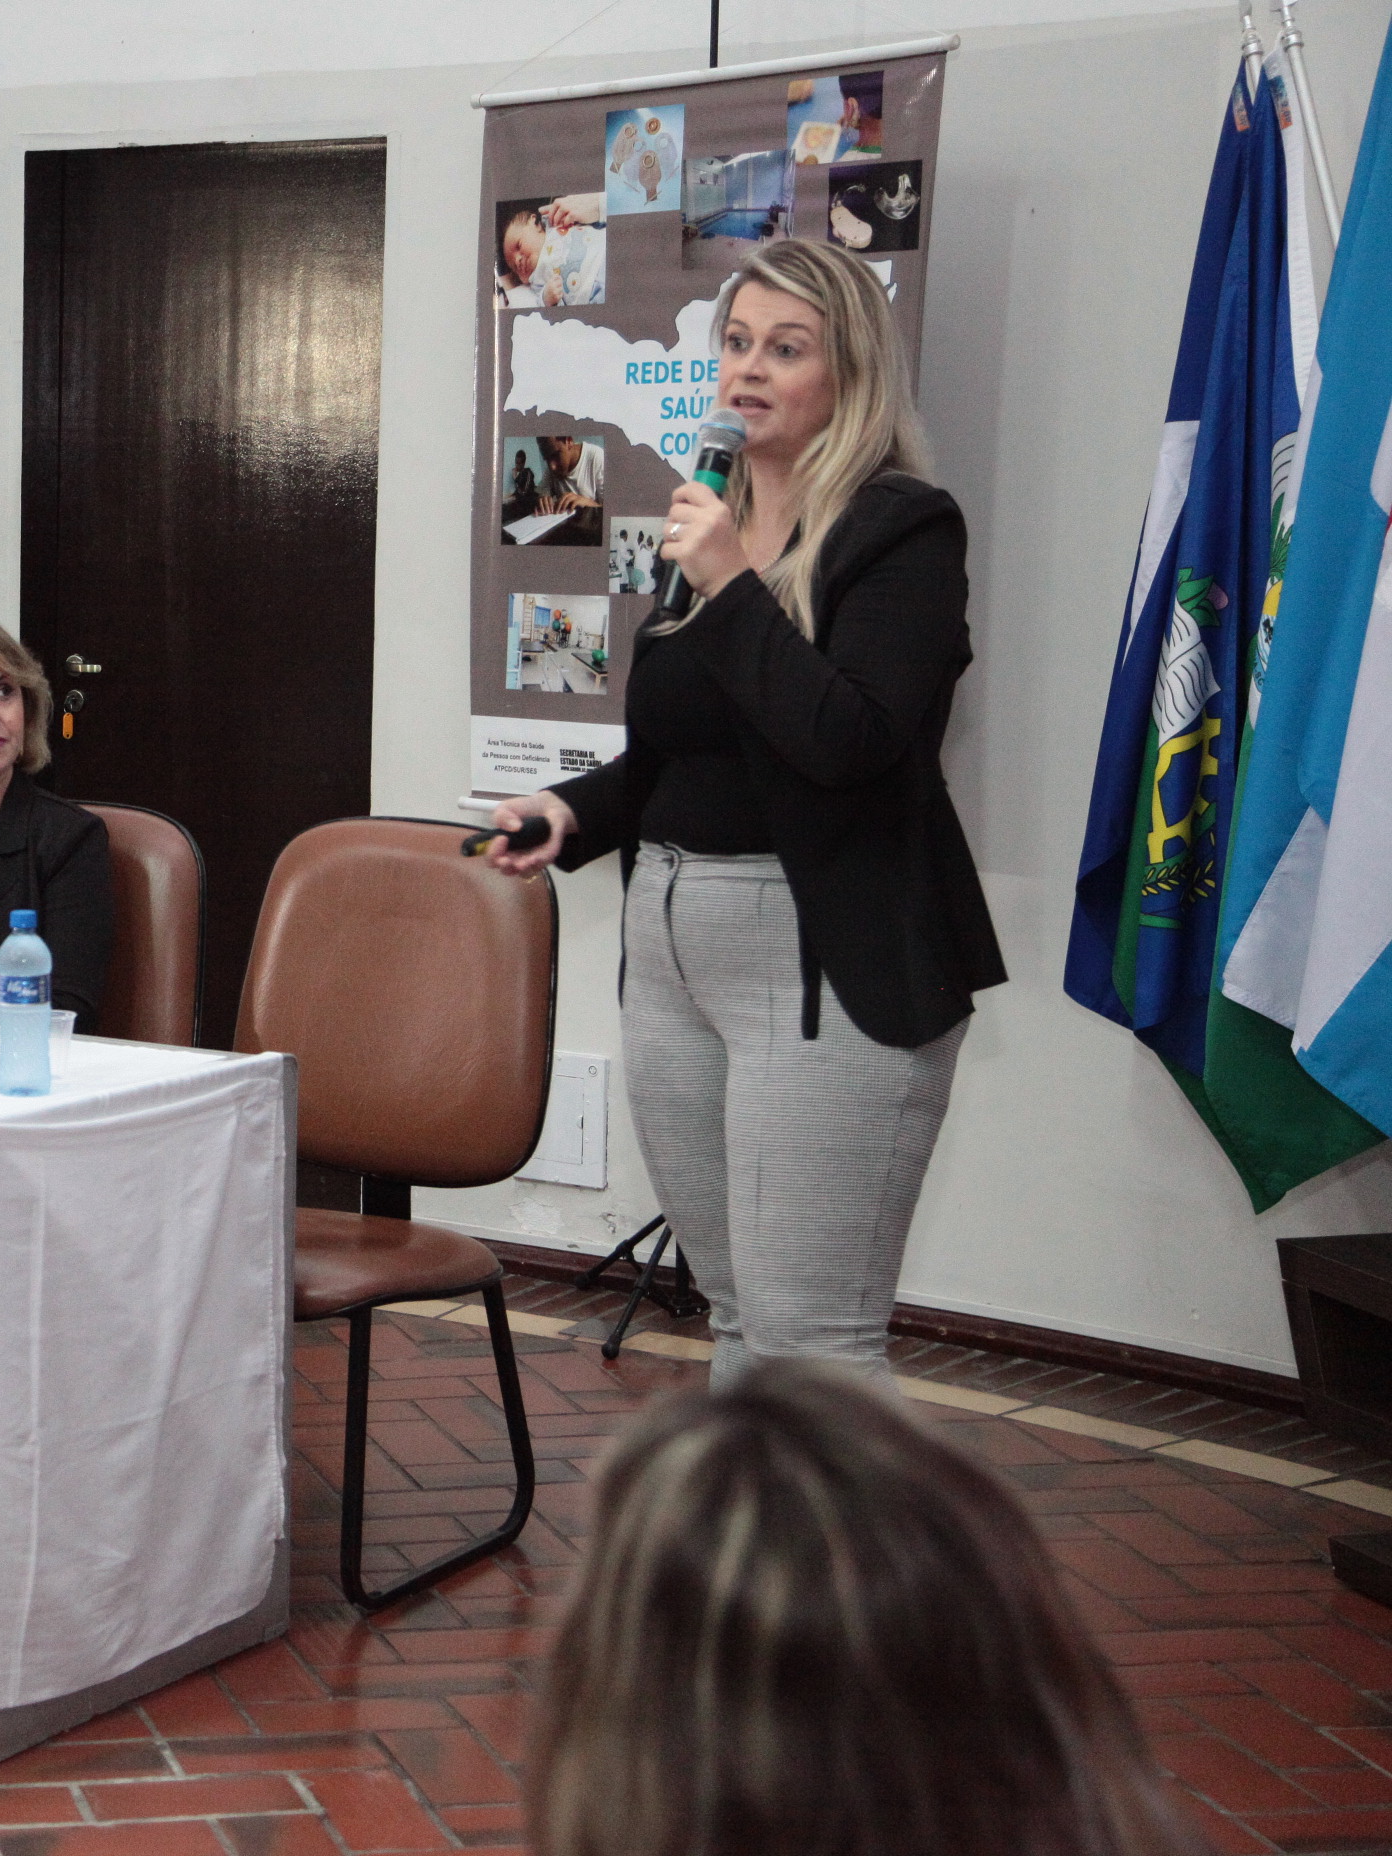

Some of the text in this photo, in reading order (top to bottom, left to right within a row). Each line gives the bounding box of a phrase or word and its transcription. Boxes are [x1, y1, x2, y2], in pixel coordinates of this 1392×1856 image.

[625, 358, 720, 385] REDE DE
[659, 432, 698, 456] CO
[560, 748, 595, 759] SECRETARIA DE
[560, 757, 578, 766] ESTADO
[579, 758, 585, 767] DA
